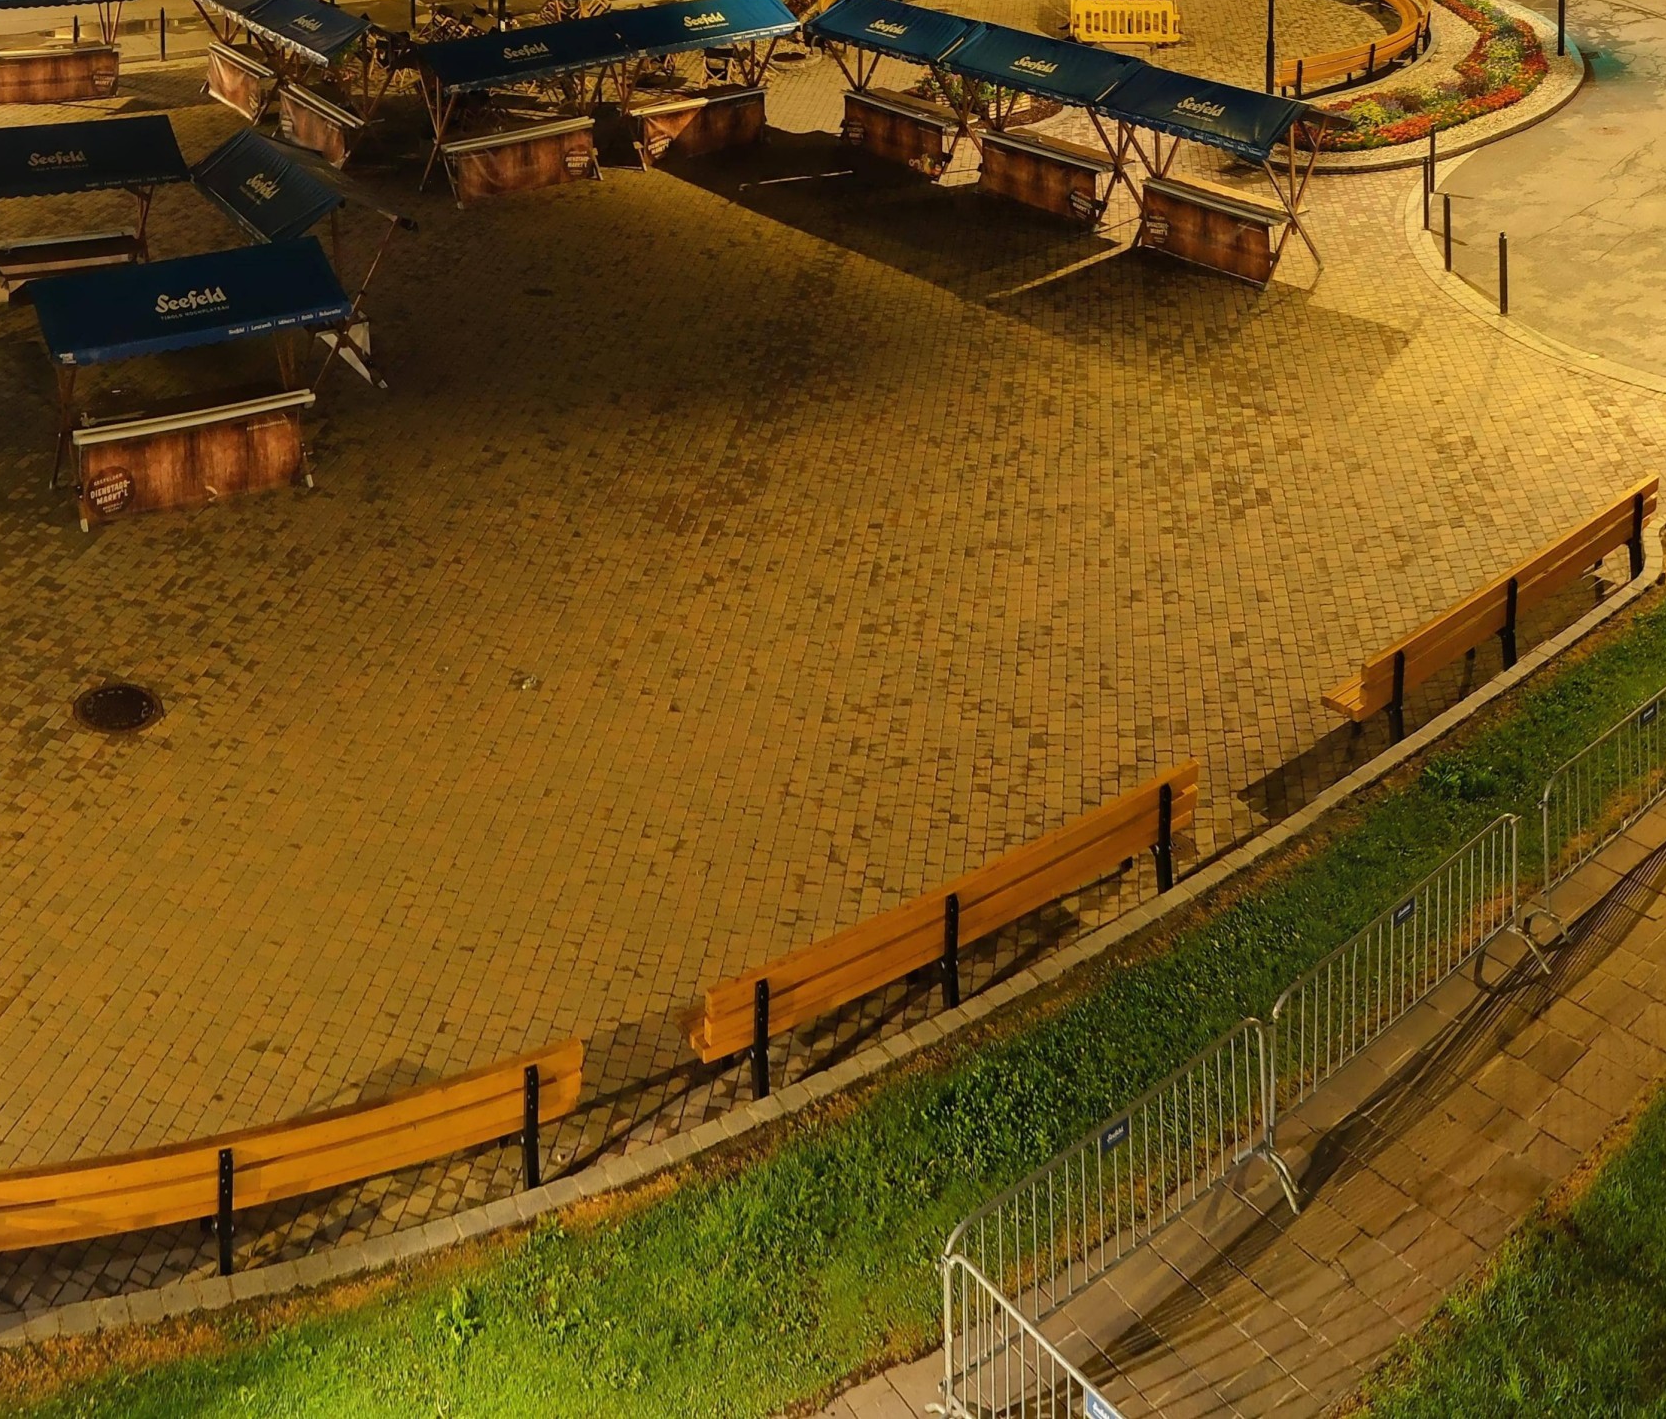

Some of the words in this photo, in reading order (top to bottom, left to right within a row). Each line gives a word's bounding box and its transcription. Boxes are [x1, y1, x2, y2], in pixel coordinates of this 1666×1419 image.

[683, 11, 726, 29] Seefeld
[503, 41, 550, 60] Seefeld
[1177, 95, 1226, 118] Seefeld
[27, 150, 87, 167] Seefeld
[155, 285, 227, 314] Seefeld
